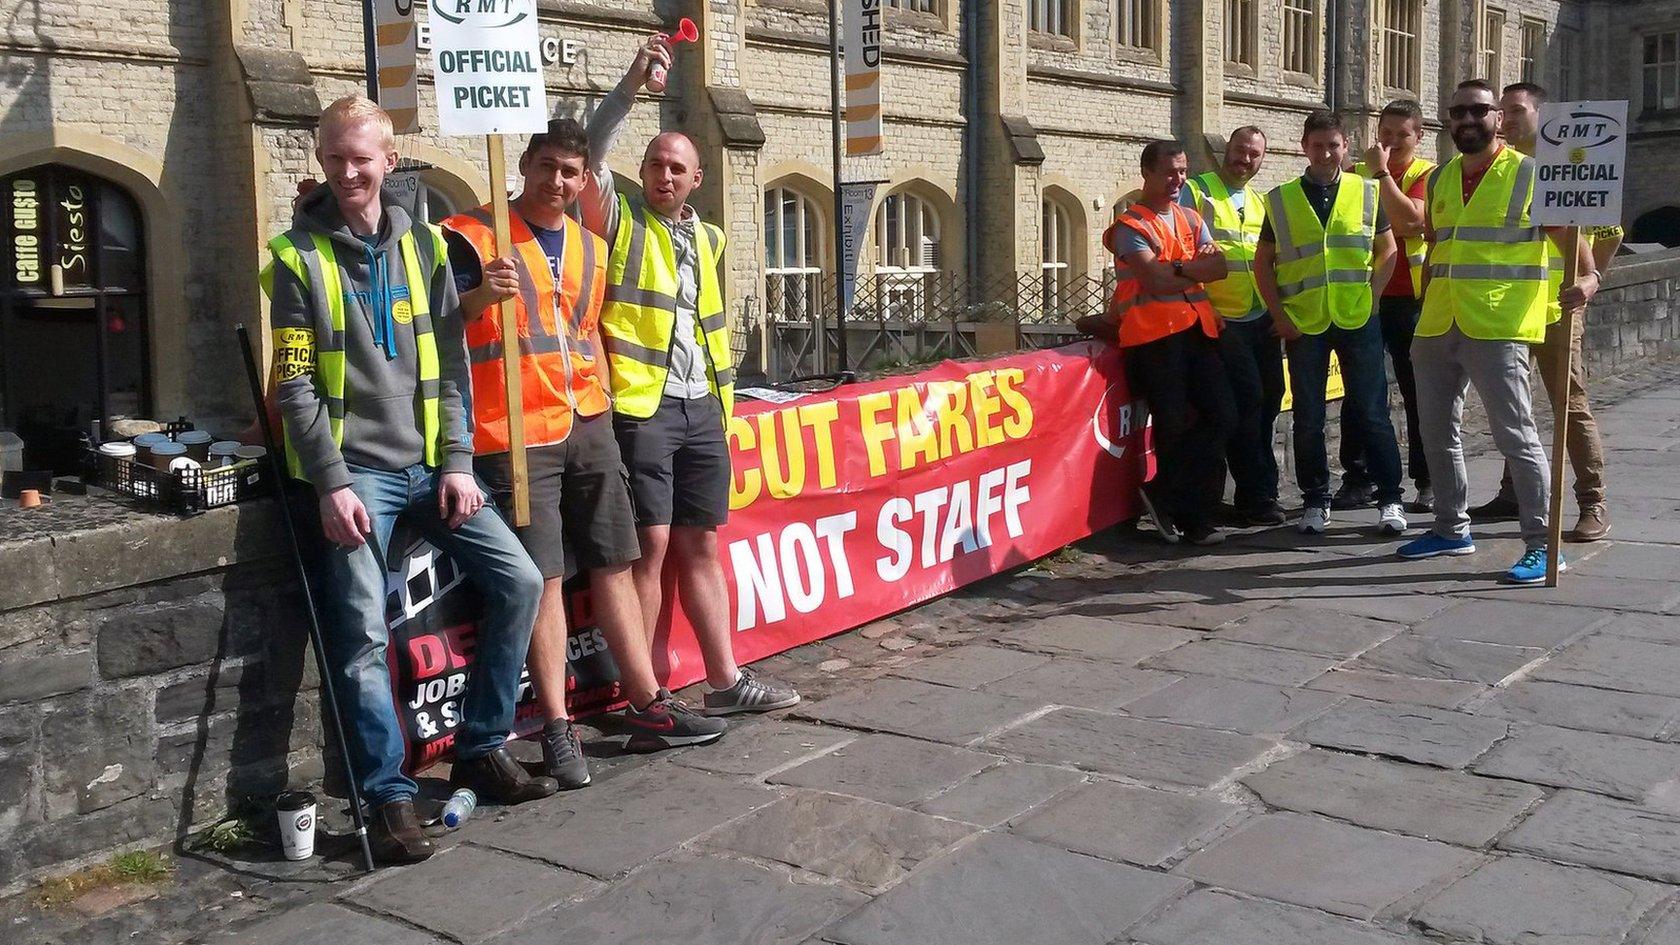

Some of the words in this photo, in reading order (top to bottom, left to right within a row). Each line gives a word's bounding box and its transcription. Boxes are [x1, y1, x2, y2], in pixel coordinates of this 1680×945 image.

[439, 50, 537, 73] OFFICIAL
[454, 86, 530, 108] PICKET
[1557, 124, 1607, 138] RMT
[1540, 164, 1618, 181] OFFICIAL
[864, 188, 873, 200] 13
[1545, 191, 1609, 207] PICKET
[729, 399, 839, 510] CUT
[858, 368, 1034, 477] FARES
[729, 511, 857, 631] NOT
[876, 459, 1031, 582] STAFF
